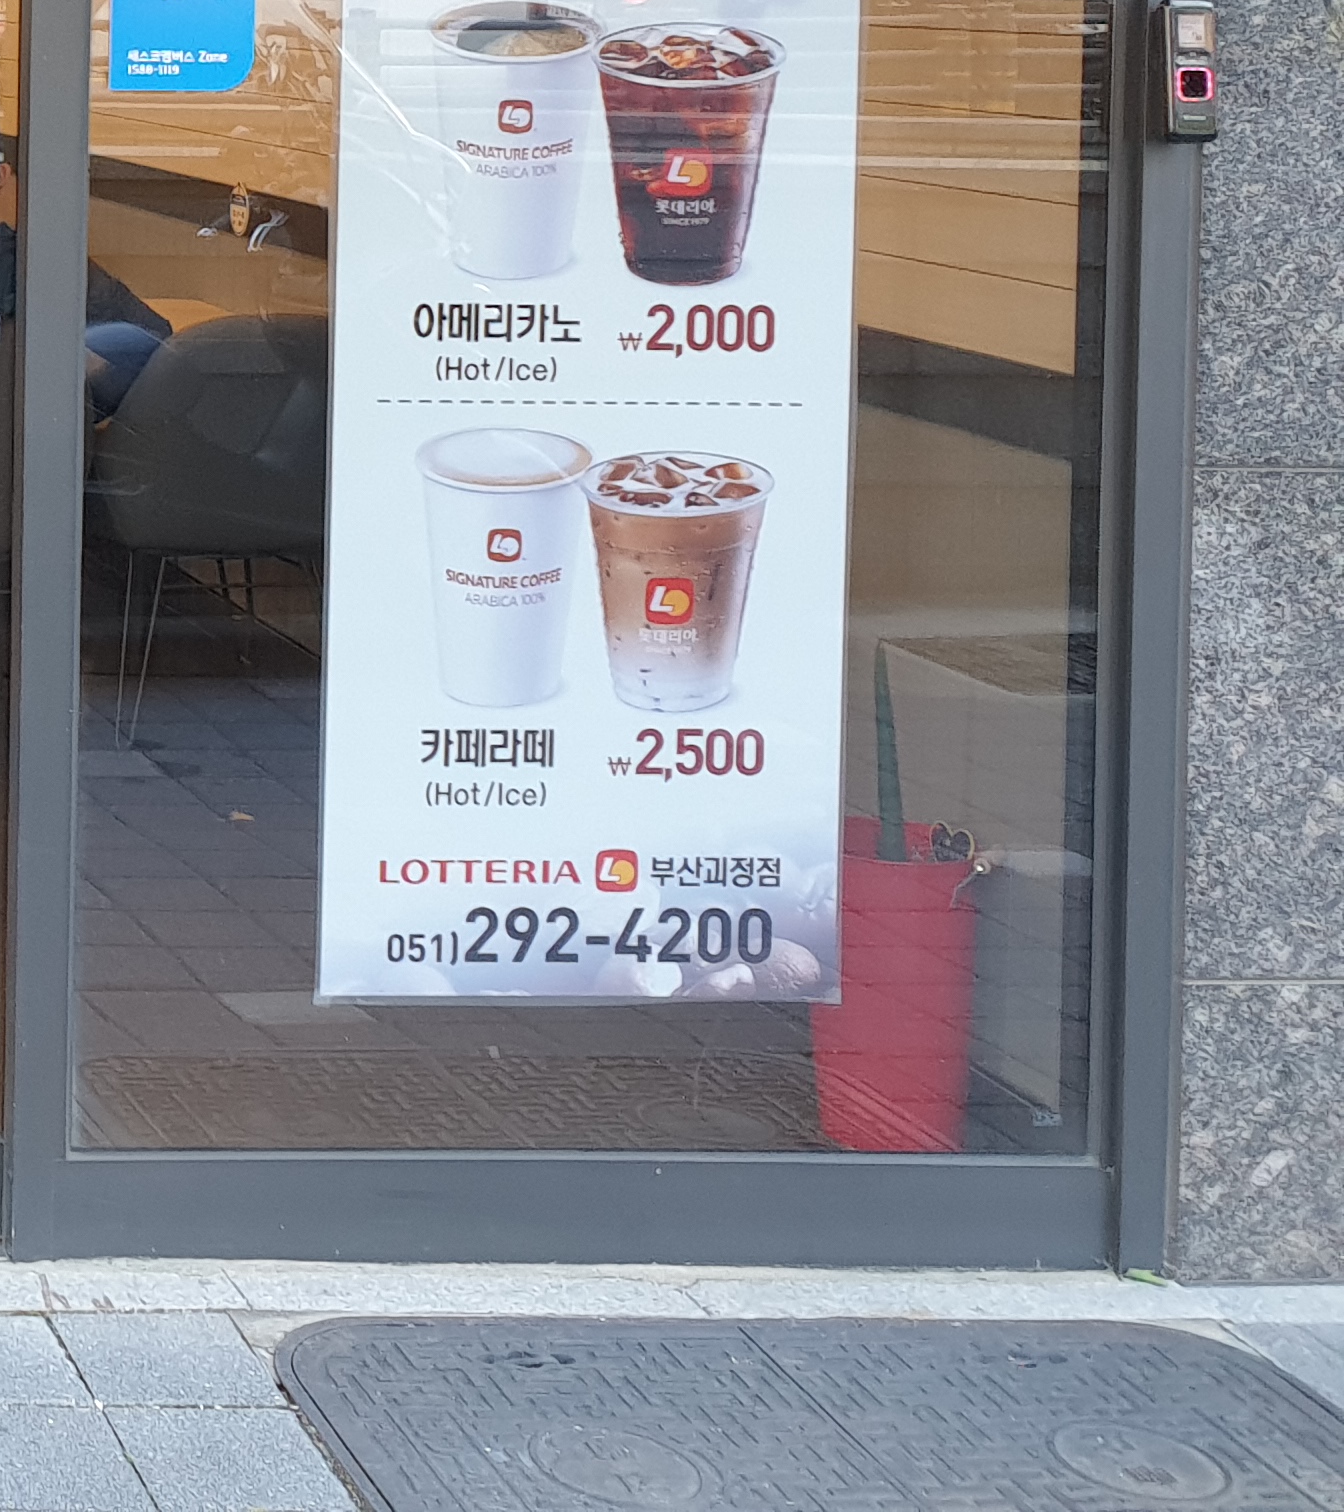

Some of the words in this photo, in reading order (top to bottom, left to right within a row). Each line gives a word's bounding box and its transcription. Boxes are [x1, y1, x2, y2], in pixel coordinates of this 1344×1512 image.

[456, 139, 529, 161] SIGNATURE
[532, 138, 573, 159] COFFEE
[413, 302, 582, 343] 아메리카노
[435, 357, 558, 384] (Hot/Ice)
[445, 568, 518, 589] SIGNATURE
[520, 567, 563, 588] COFFEE
[420, 729, 554, 769] 카페라떼
[425, 781, 548, 807] (Hot/Ice)
[378, 859, 581, 885] LOTTERIA
[651, 857, 782, 888] 부산괴정점
[387, 907, 773, 966] 051)292-4200
